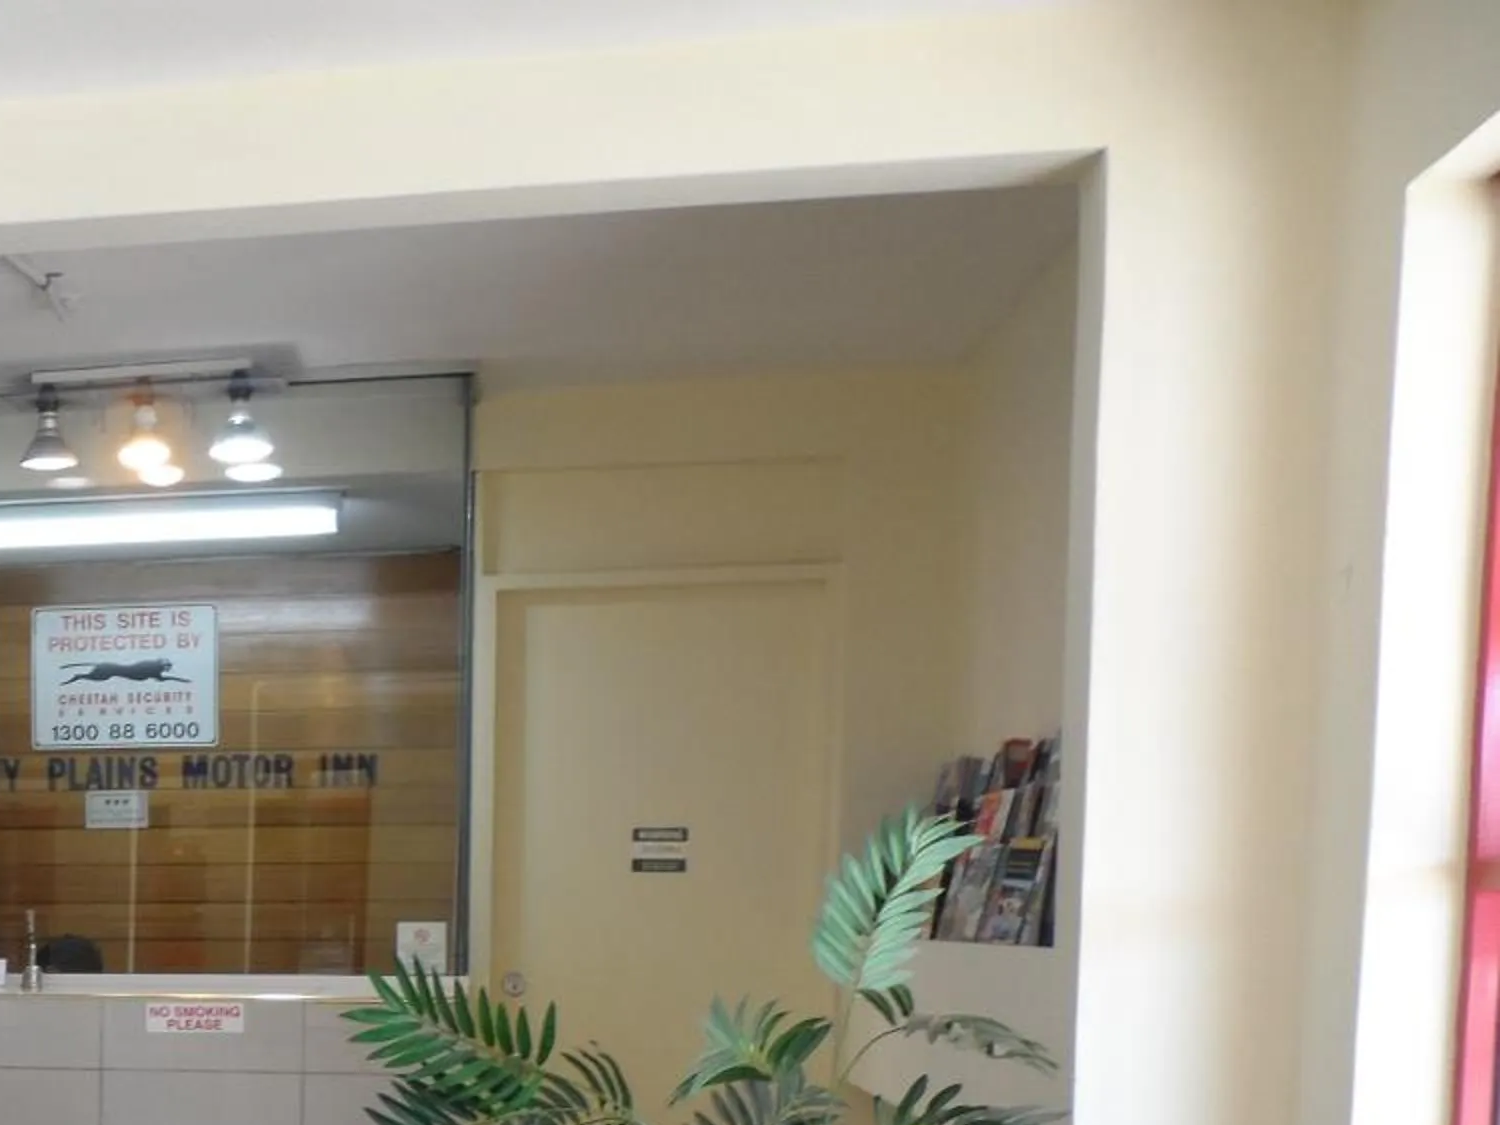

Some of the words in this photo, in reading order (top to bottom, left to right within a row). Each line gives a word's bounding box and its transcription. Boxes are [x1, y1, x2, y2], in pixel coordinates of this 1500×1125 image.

[61, 614, 106, 631] THIS
[117, 612, 160, 629] SITE
[172, 611, 190, 627] IS
[50, 634, 166, 652] PROTECTED
[177, 633, 201, 649] BY
[58, 694, 118, 705] CHEETAH
[128, 691, 192, 704] SECURITY
[52, 724, 99, 741] 1300
[109, 723, 135, 739] 88
[146, 722, 199, 739] 6000
[49, 756, 158, 791] PLAINS
[183, 754, 293, 789] MOTOR
[319, 753, 378, 788] INN
[150, 1007, 170, 1017] NO
[175, 1006, 240, 1017] SMOKING
[166, 1019, 222, 1030] PLEASE
